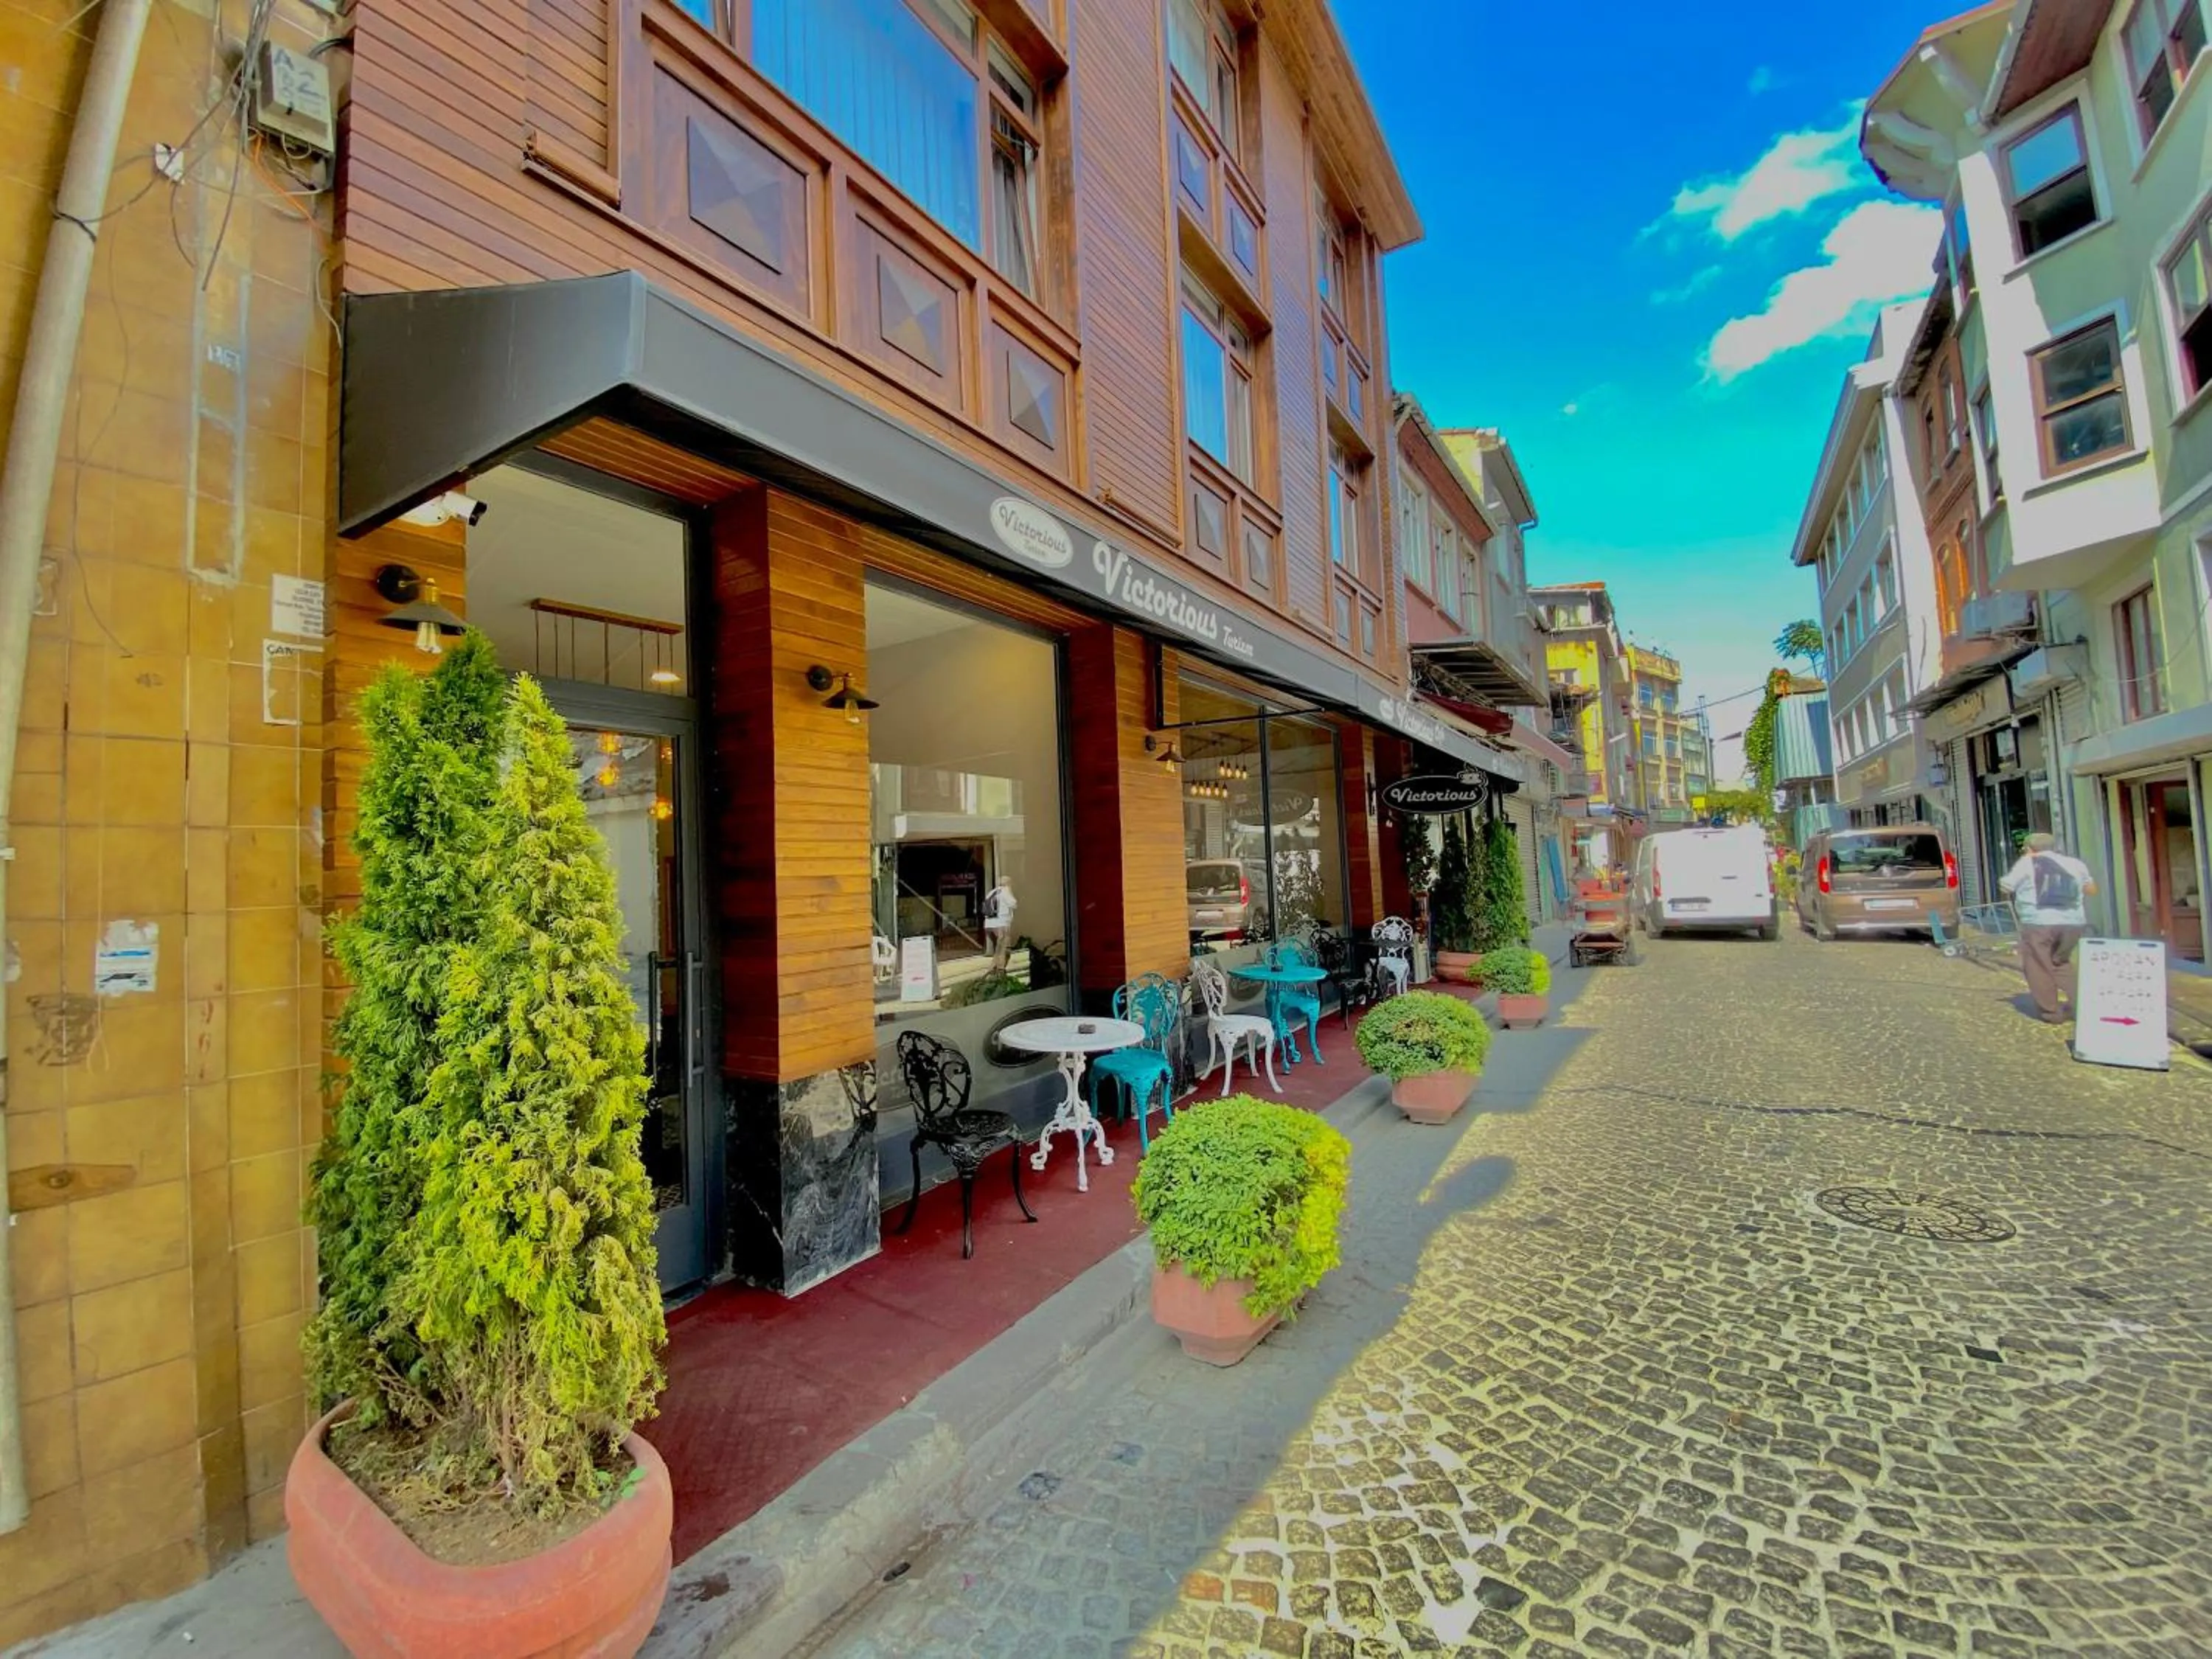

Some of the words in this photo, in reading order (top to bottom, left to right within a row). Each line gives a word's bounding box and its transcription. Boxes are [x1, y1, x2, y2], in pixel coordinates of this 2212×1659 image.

[998, 504, 1067, 554] Victorious
[1092, 539, 1218, 640] Victorious
[1390, 787, 1478, 803] Victorious
